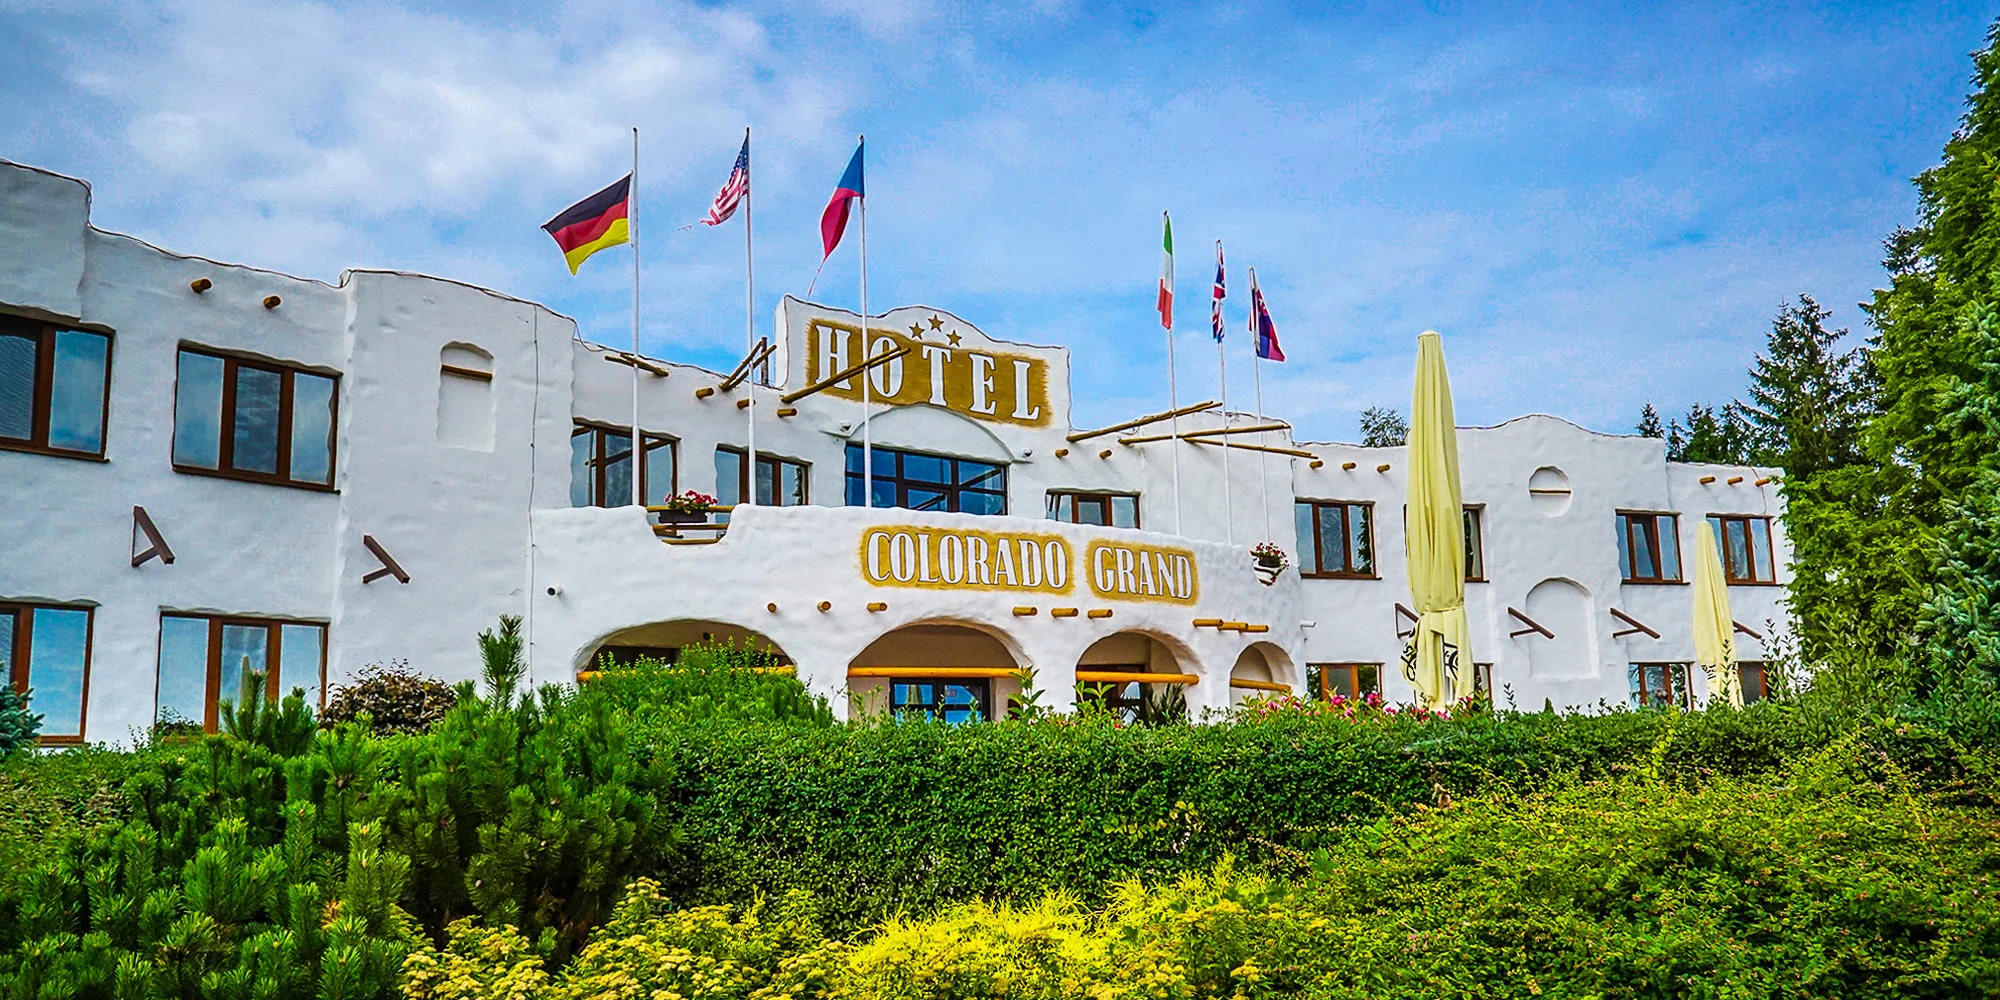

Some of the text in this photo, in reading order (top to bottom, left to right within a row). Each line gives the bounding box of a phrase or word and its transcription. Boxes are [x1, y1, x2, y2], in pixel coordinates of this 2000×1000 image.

[815, 324, 1041, 421] HOTEL
[867, 532, 1194, 599] COLORADO GRAND
